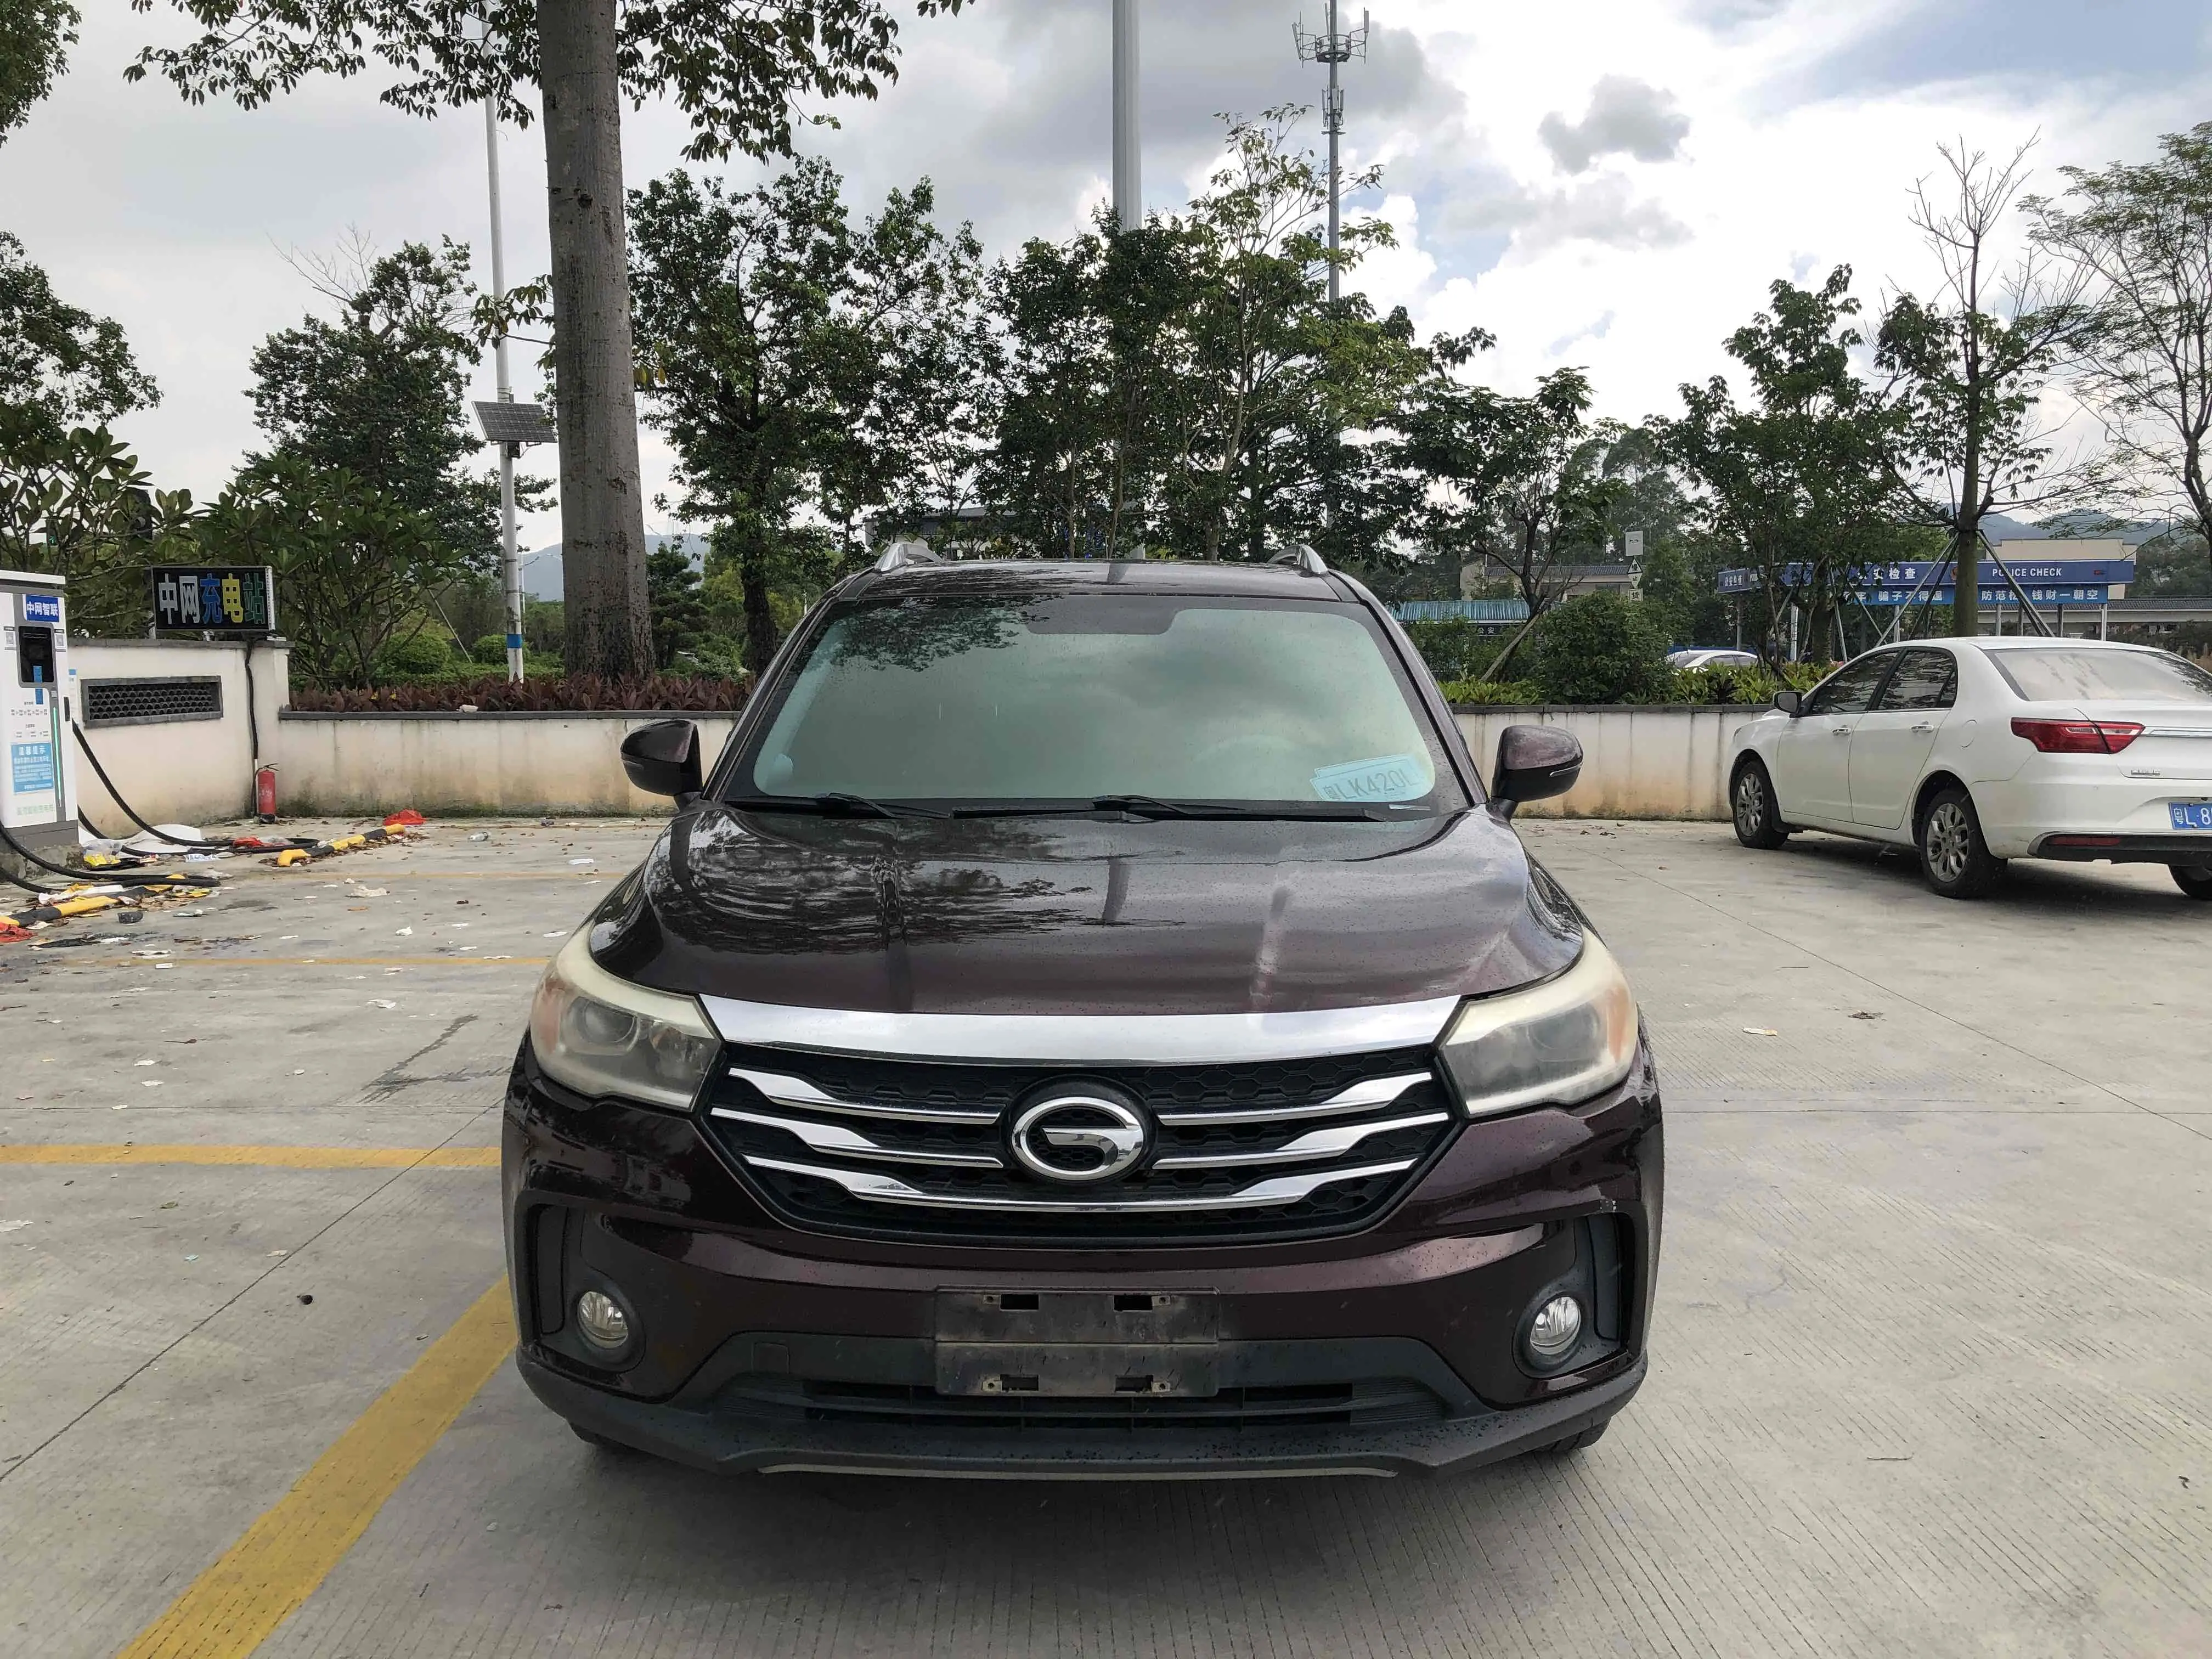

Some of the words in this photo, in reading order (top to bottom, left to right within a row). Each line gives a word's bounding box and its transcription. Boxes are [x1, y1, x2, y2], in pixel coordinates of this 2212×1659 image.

[1992, 568, 2027, 577] POICE
[2030, 568, 2062, 576] CHECK
[159, 573, 266, 624] 中网充电站
[2032, 589, 2098, 601] 钱财一朝空
[27, 601, 59, 616] 中网智联
[2173, 807, 2212, 827] 粤L·8
